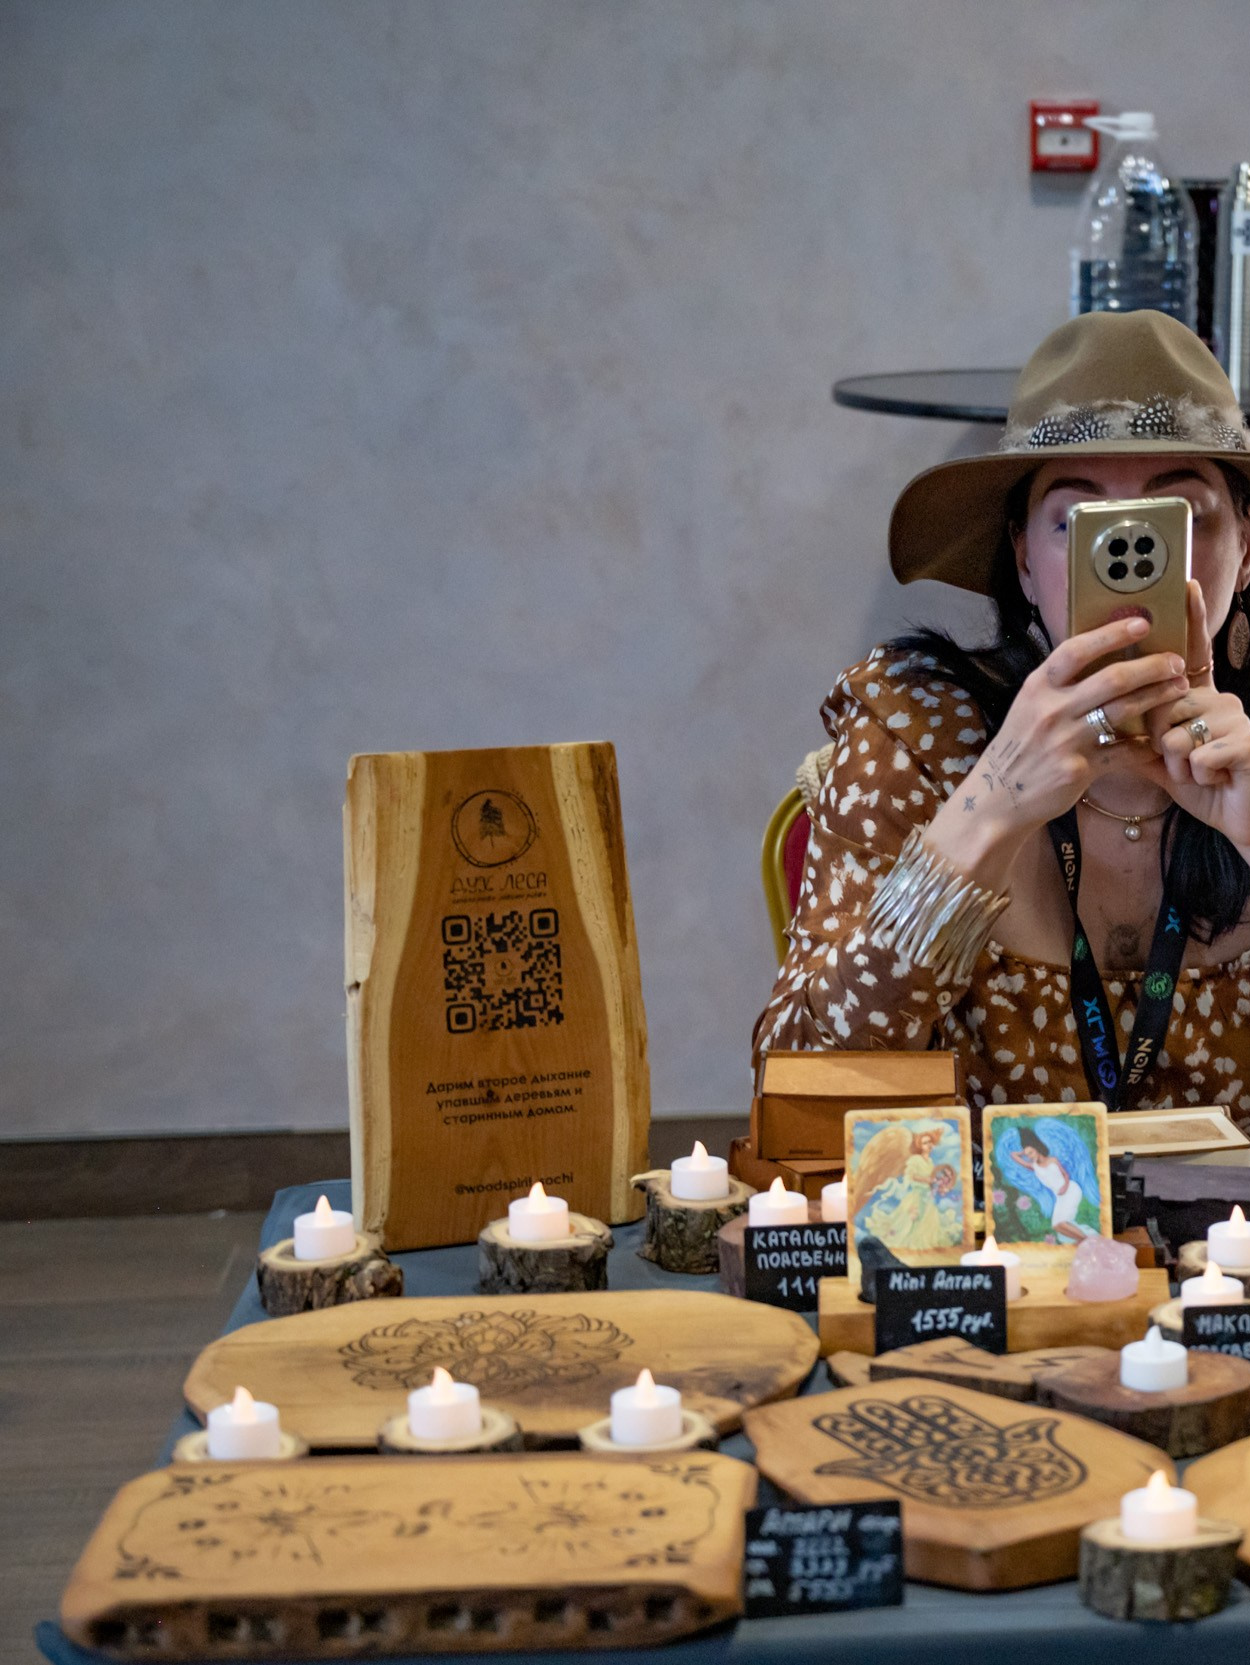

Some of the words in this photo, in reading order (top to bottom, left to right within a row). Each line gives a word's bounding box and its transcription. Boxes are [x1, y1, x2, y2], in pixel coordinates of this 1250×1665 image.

[450, 875, 495, 894] ДУХ
[1126, 1037, 1154, 1085] NOIR
[426, 1081, 474, 1095] Дарим
[478, 1074, 527, 1089] второе
[530, 1068, 592, 1085] дыхание
[504, 1088, 571, 1105] деревьям
[574, 1087, 583, 1096] и
[443, 1110, 523, 1126] старинным
[527, 1103, 578, 1118] домам.
[454, 1172, 574, 1195] @woodspiritsochi
[757, 1250, 845, 1271] ПОДСВЕЧН
[777, 1275, 816, 1298] 111
